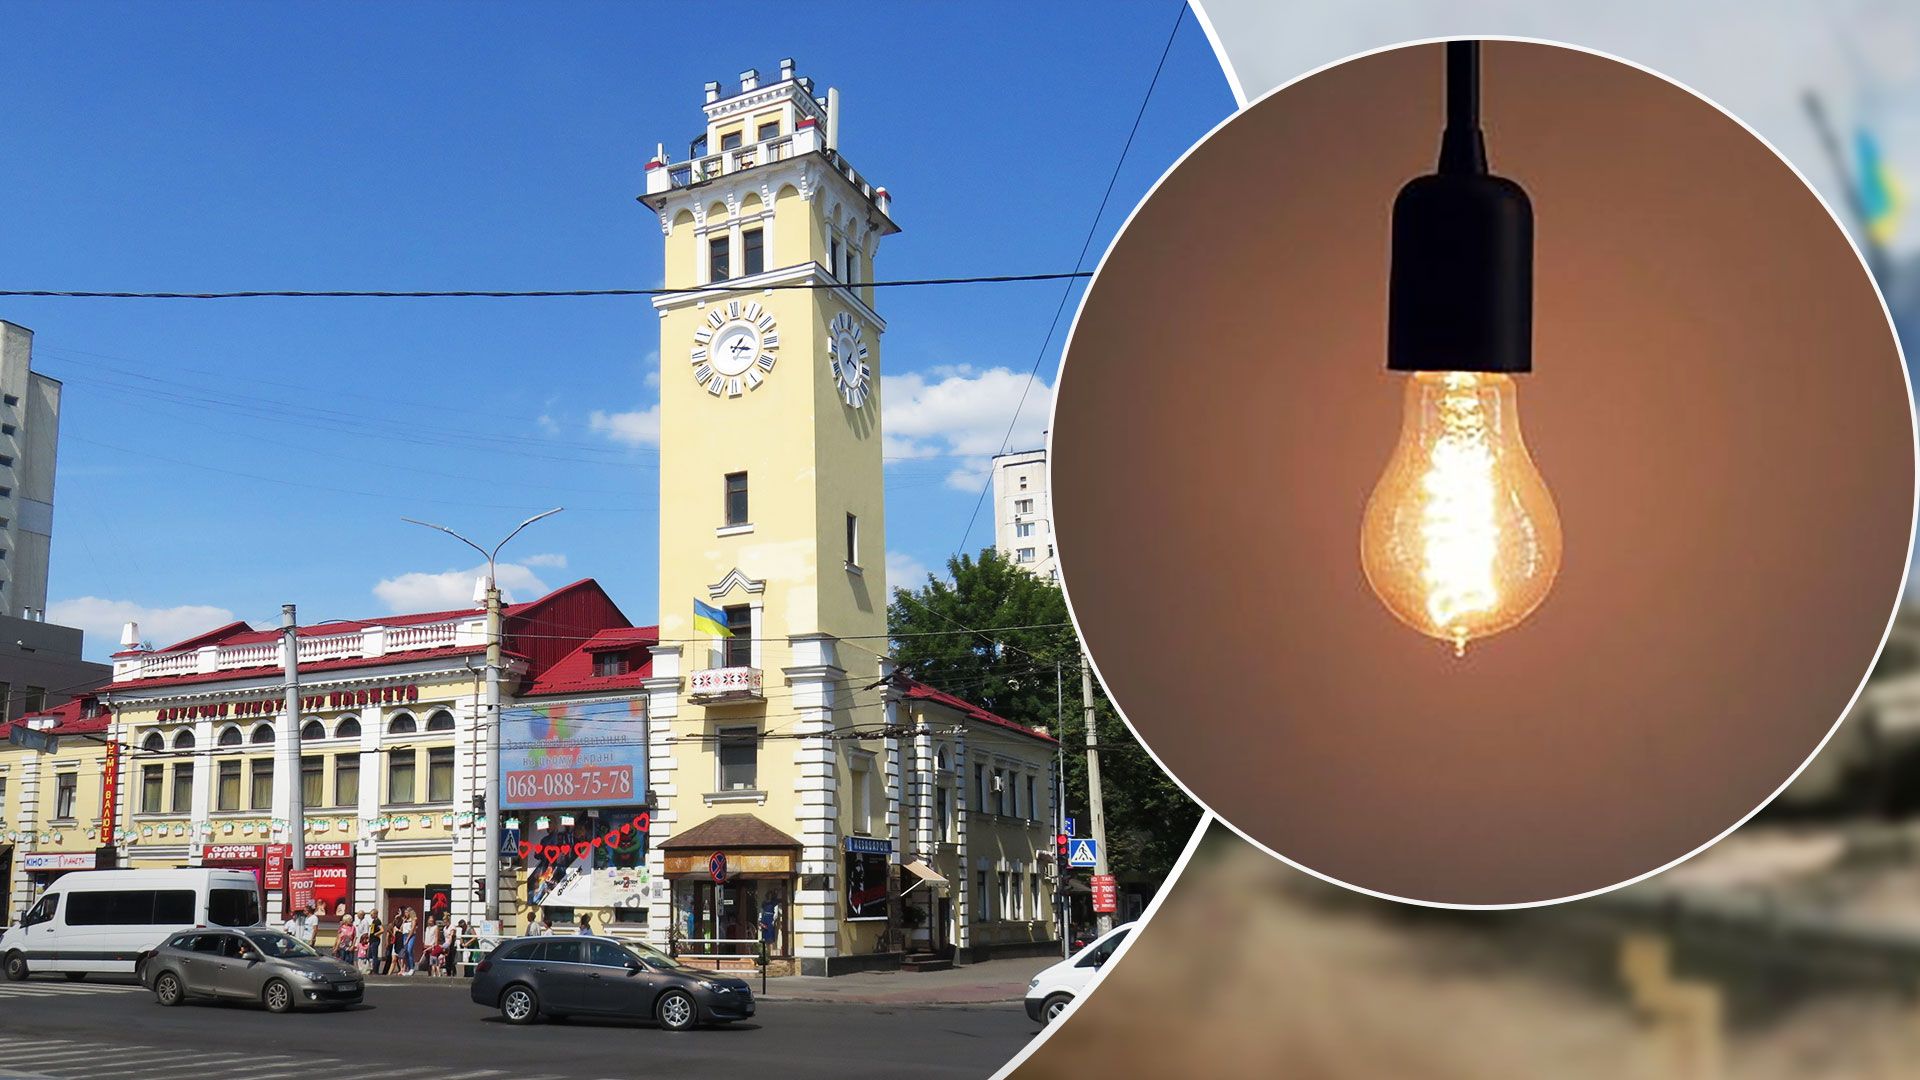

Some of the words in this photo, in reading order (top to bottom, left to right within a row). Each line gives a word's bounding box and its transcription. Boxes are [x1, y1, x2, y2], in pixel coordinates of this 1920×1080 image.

[329, 684, 419, 707] ПЛАНЕТА
[507, 769, 630, 798] 068-088-75-78
[211, 845, 255, 853] СЬОГОДНІ
[305, 843, 342, 851] ОГОДНІ
[291, 880, 314, 890] 7007
